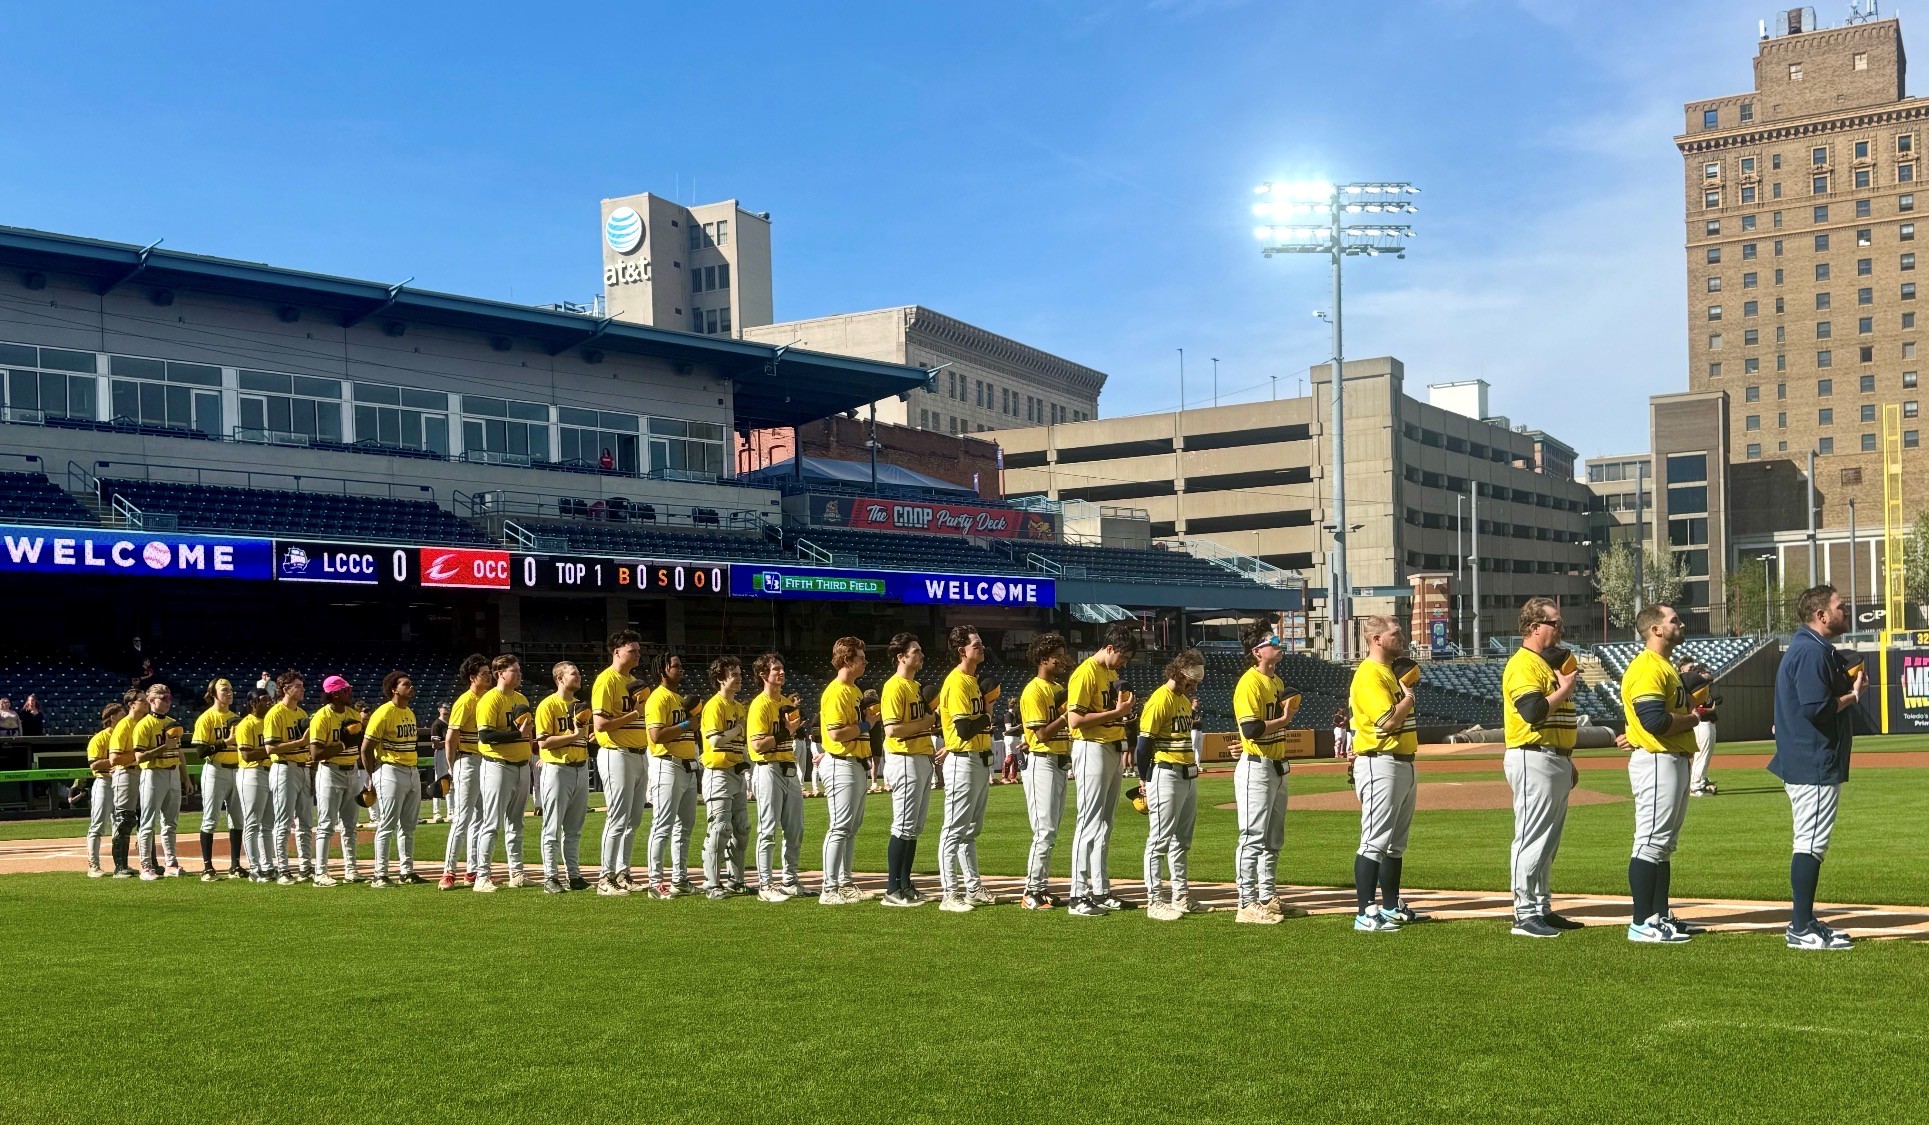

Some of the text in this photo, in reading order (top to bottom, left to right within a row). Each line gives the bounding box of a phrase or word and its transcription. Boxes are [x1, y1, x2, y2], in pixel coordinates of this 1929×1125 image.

[604, 256, 651, 285] at&t
[866, 504, 888, 523] The
[893, 505, 933, 528] COOP
[936, 510, 974, 534] Party
[976, 513, 1007, 531] Deck
[4, 535, 234, 571] WELCOME
[323, 552, 374, 574] LCCC
[392, 549, 407, 582] 0
[473, 559, 508, 579] OCC
[523, 556, 537, 587] 0
[555, 562, 602, 586] TOP 1
[618, 567, 630, 585] B
[636, 564, 647, 590] 0
[658, 569, 668, 587] S
[674, 566, 685, 591] 0
[711, 568, 722, 592] 0
[924, 579, 1037, 602] WELCOME
